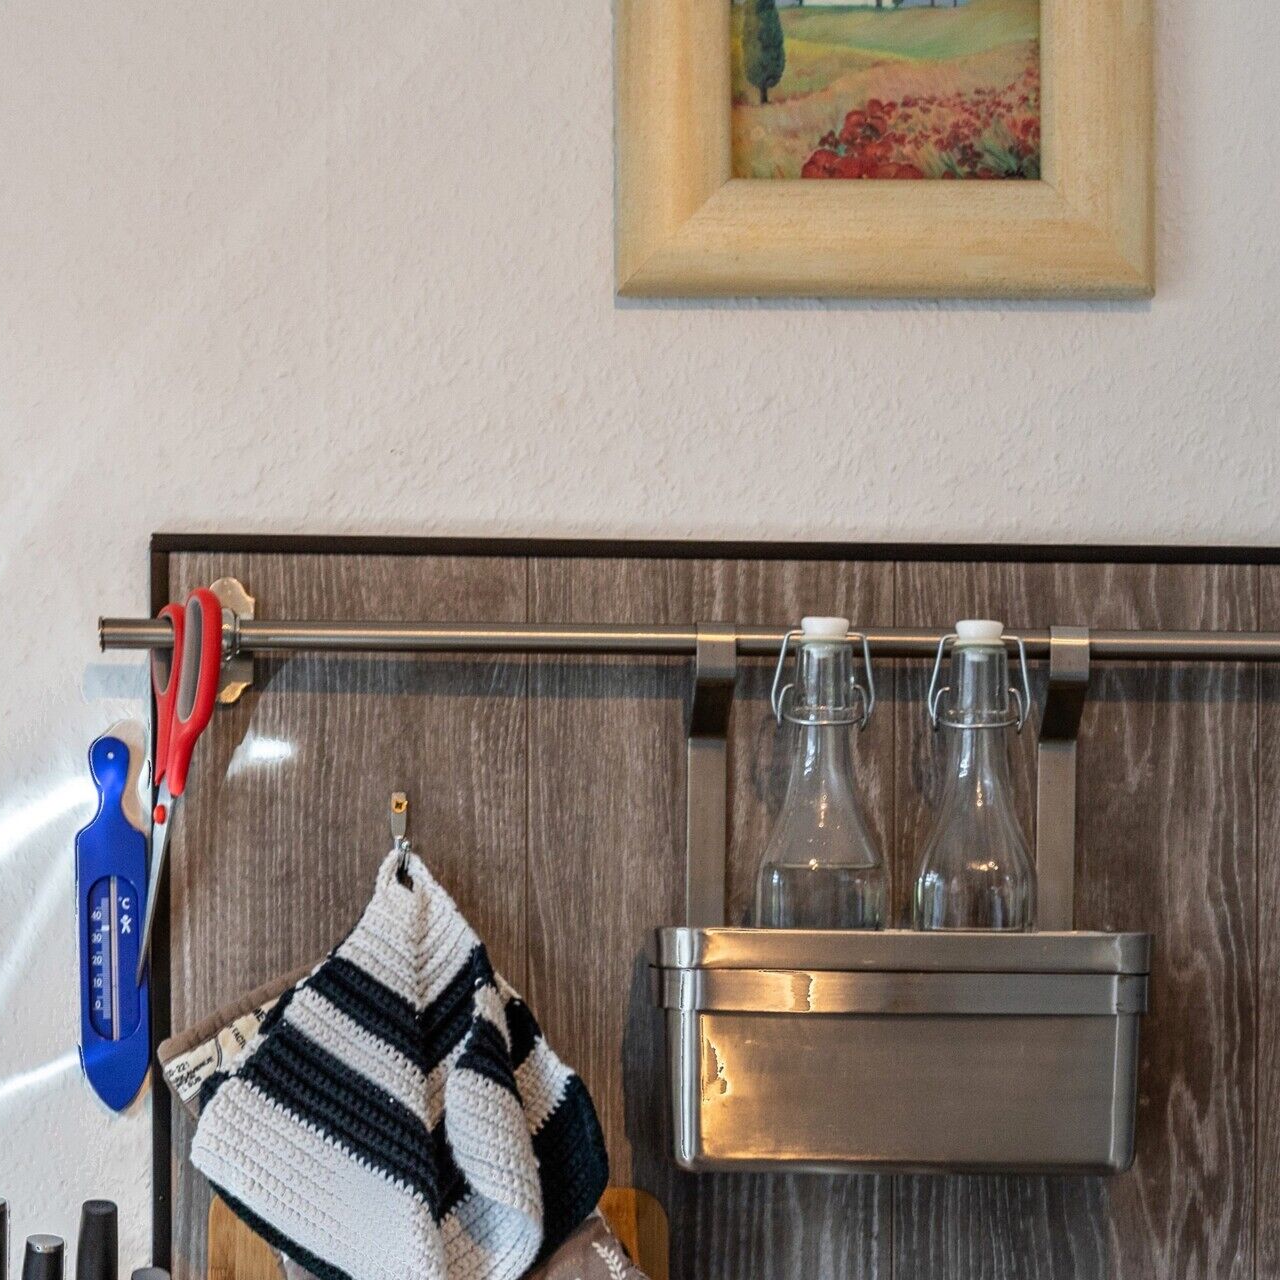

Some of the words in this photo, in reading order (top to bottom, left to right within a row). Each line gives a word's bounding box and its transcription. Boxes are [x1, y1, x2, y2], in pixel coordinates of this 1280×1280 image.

[91, 910, 102, 920] 40
[91, 933, 102, 944] 30
[92, 955, 102, 966] 20
[93, 977, 102, 988] 10
[95, 999, 101, 1009] 0
